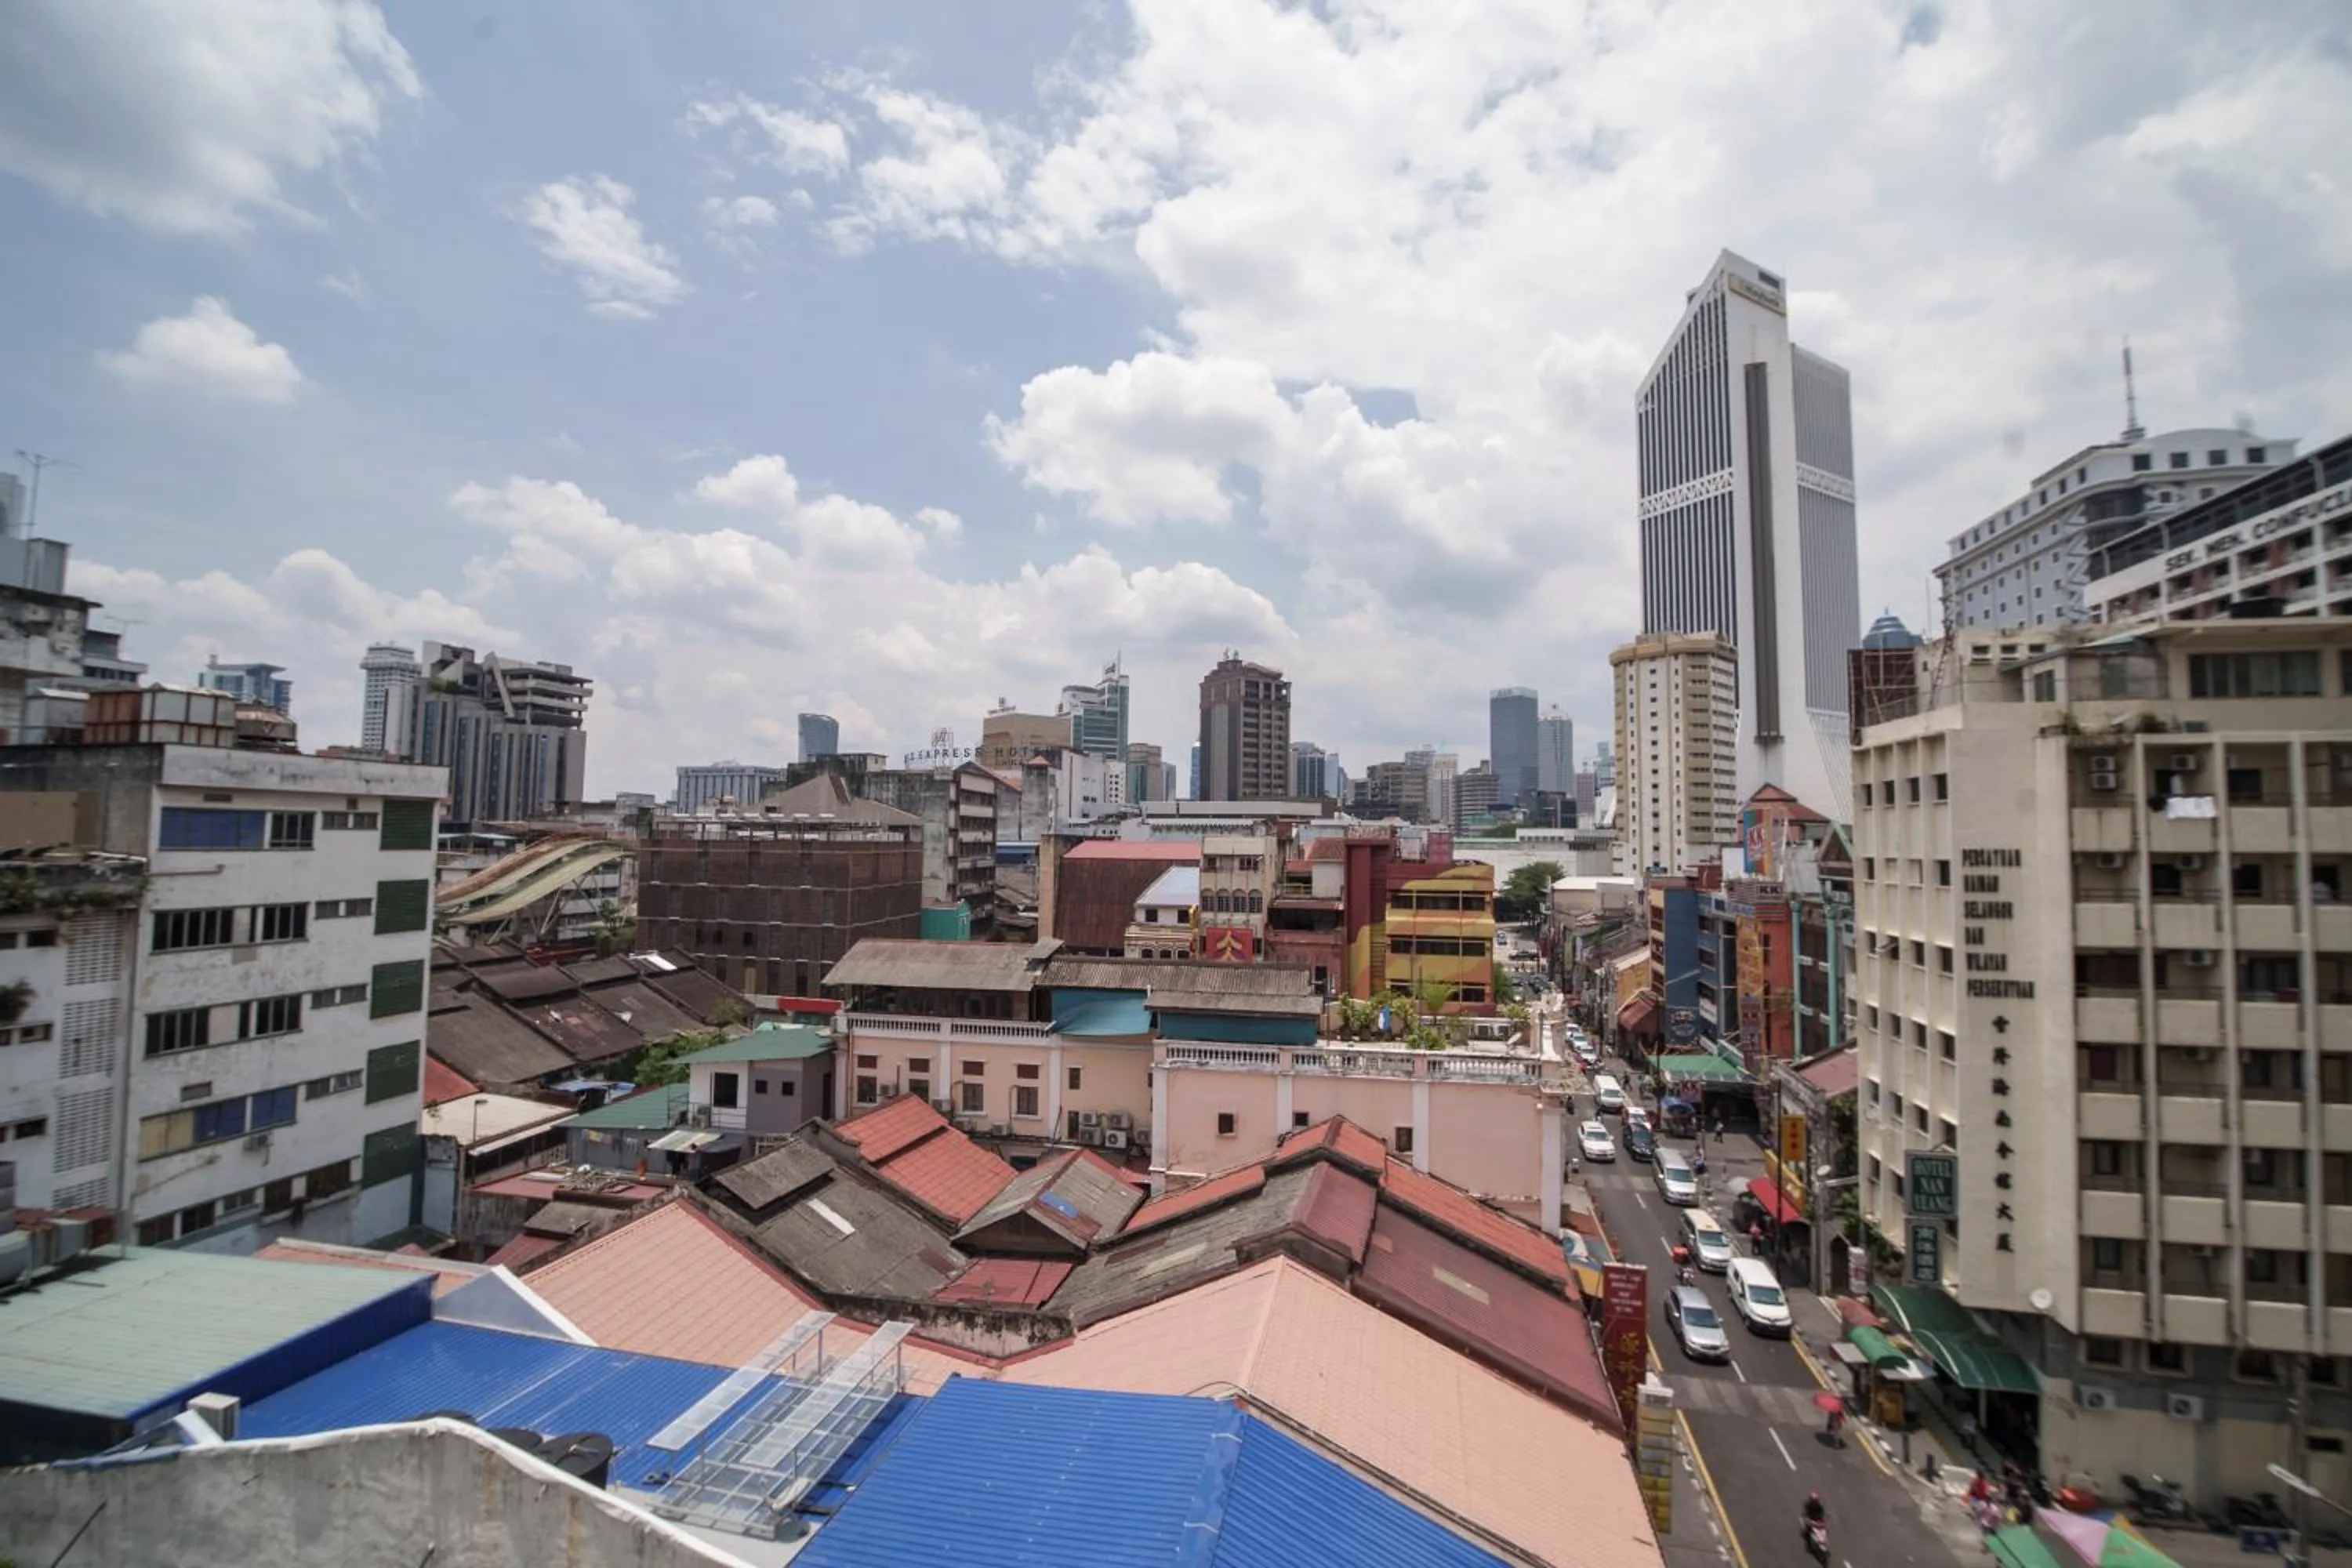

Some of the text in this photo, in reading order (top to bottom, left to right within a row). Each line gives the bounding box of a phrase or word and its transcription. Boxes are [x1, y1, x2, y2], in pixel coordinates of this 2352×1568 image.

[2252, 489, 2352, 539] CONFUCI
[1962, 849, 2020, 867] PERSATUAN
[1964, 901, 2013, 920] SELANGOR
[1967, 978, 2034, 999] PERSEKUTUAN
[1914, 1160, 1951, 1178] HOTEL
[1919, 1177, 1945, 1193] NAN
